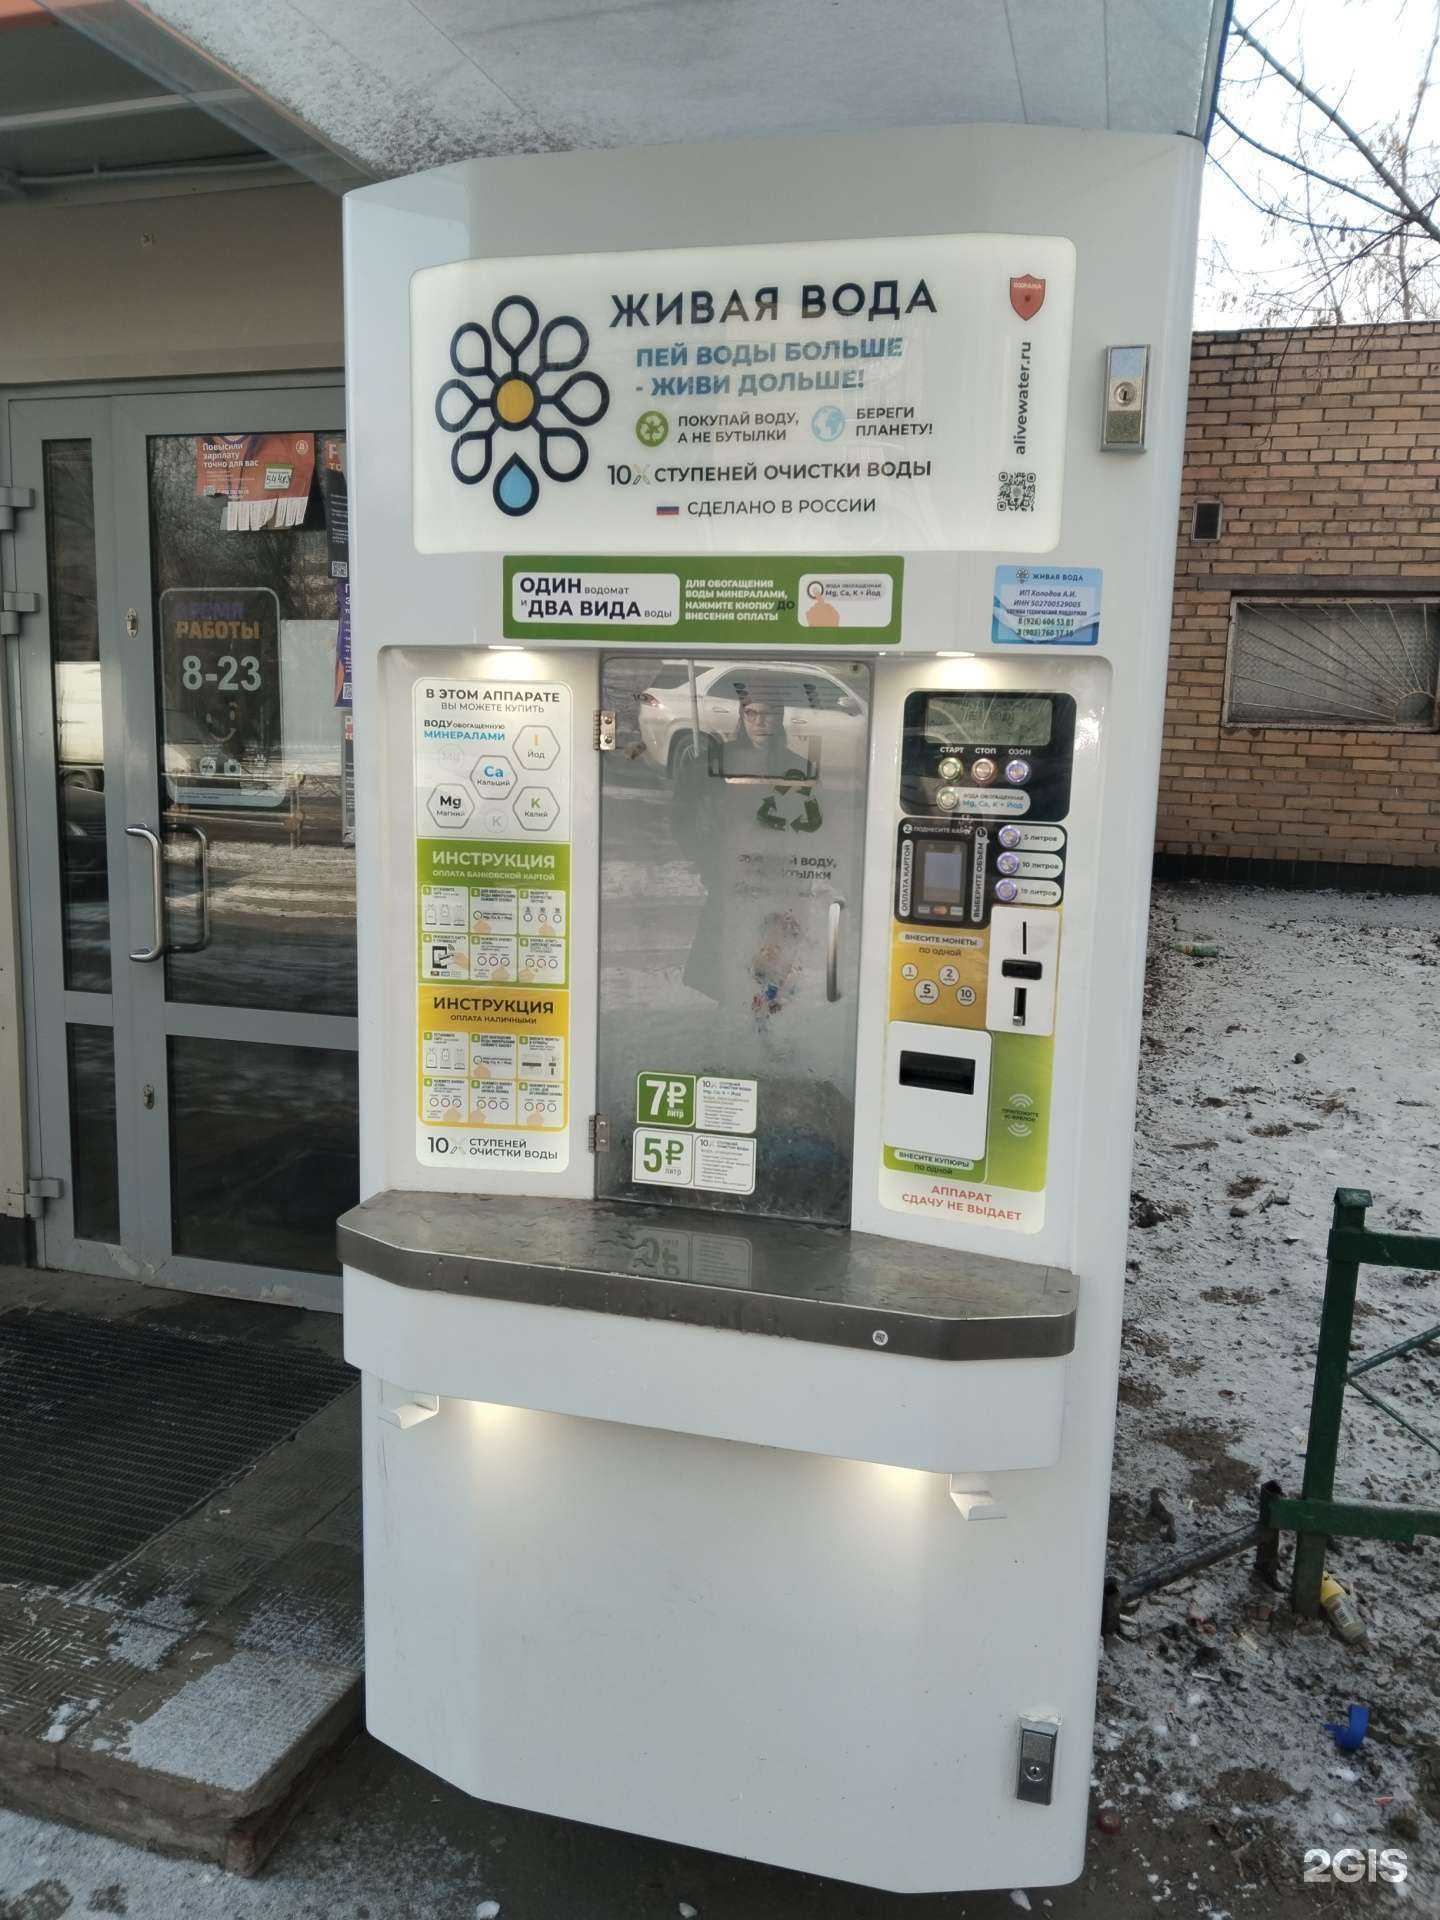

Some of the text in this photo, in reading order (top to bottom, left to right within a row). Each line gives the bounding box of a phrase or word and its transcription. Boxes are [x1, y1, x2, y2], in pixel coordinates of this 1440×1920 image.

[610, 279, 937, 327] ЖИВАЯ ВОДА
[636, 337, 903, 368] ПЕЙ ВОДЫ БОЛЬШЕ
[651, 374, 730, 396] ЖИВИ
[738, 369, 864, 396] ДОЛЬШЕ!
[1013, 341, 1032, 455] alivewater.ru
[678, 412, 799, 427] ПОКУПАЙ ВОДУ,
[857, 407, 915, 420] БЕРЕГИ
[678, 429, 786, 443] А НЕ БУТЫЛКИ
[856, 424, 933, 437] ПЛАНЕТУ!
[203, 442, 243, 451] Повысили
[203, 452, 240, 460] зарплату
[607, 461, 932, 485] 10 СТУПЕНЕЙ ОЧИСТКИ ВОДЫ
[687, 498, 876, 517] СДЕЛАНО В РОССИИ
[1032, 573, 1084, 582] ЖИВАЯ ВОДА
[520, 577, 630, 596] ОДИН водомат
[686, 580, 774, 589] ДЛЯ ОБОГАЩЕНИЯ
[685, 590, 788, 599] ВОДЫ МИНЕРАЛАМИ,
[528, 600, 573, 618] ДВА
[580, 601, 642, 620] ВИДА
[644, 610, 672, 619] воды
[685, 600, 795, 611] НАЖМИТЕ КНОПКУ ДО
[685, 611, 778, 621] ВНЕСЕНИЯ ОПЛАТЫ
[176, 621, 260, 640] РАБОТЫ
[182, 655, 262, 691] 8-23
[425, 688, 560, 703] В ЭТОМ АППАРАТЕ
[441, 702, 544, 713] ВЫ МОЖЕТЕ КУПИТЬ
[424, 719, 453, 728] ВОДУ
[424, 730, 505, 741] МИНЕРАЛАМИ
[940, 746, 965, 754] СТАРТ
[1008, 748, 1032, 756] ОЗОН
[484, 765, 504, 777] Ca
[440, 795, 462, 809] Mg
[531, 798, 541, 808] K
[1029, 834, 1057, 842] литров
[432, 851, 555, 870] ИНСТРУКЦИЯ
[432, 870, 555, 881] ОПЛАТА БАНКОВСКОЙ КАРТОЙ
[904, 933, 977, 946] ВНЕСИТЕ МОНЕТЫ
[932, 947, 962, 957] ОДНОЙ
[946, 969, 953, 978] 2
[923, 984, 931, 994] 5
[961, 989, 972, 998] 10
[433, 997, 554, 1015] ИНСТРУКЦИЯ
[450, 1014, 537, 1025] ОПЛАТА НАЛИЧНЫМИ
[427, 1136, 527, 1154] 10 СТУПЕНЕЙ
[469, 1147, 558, 1160] ОЧИСТКИ ВОДЫ
[899, 1151, 970, 1168] ВНЕСИТЕ КУПЮРЫ
[664, 1168, 682, 1177] литр
[914, 1164, 953, 1176] ПО ОДНОЙ
[931, 1185, 993, 1203] АППАРАТ
[901, 1193, 1023, 1221] СДАЧУ НЕ ВЫДАЕТ
